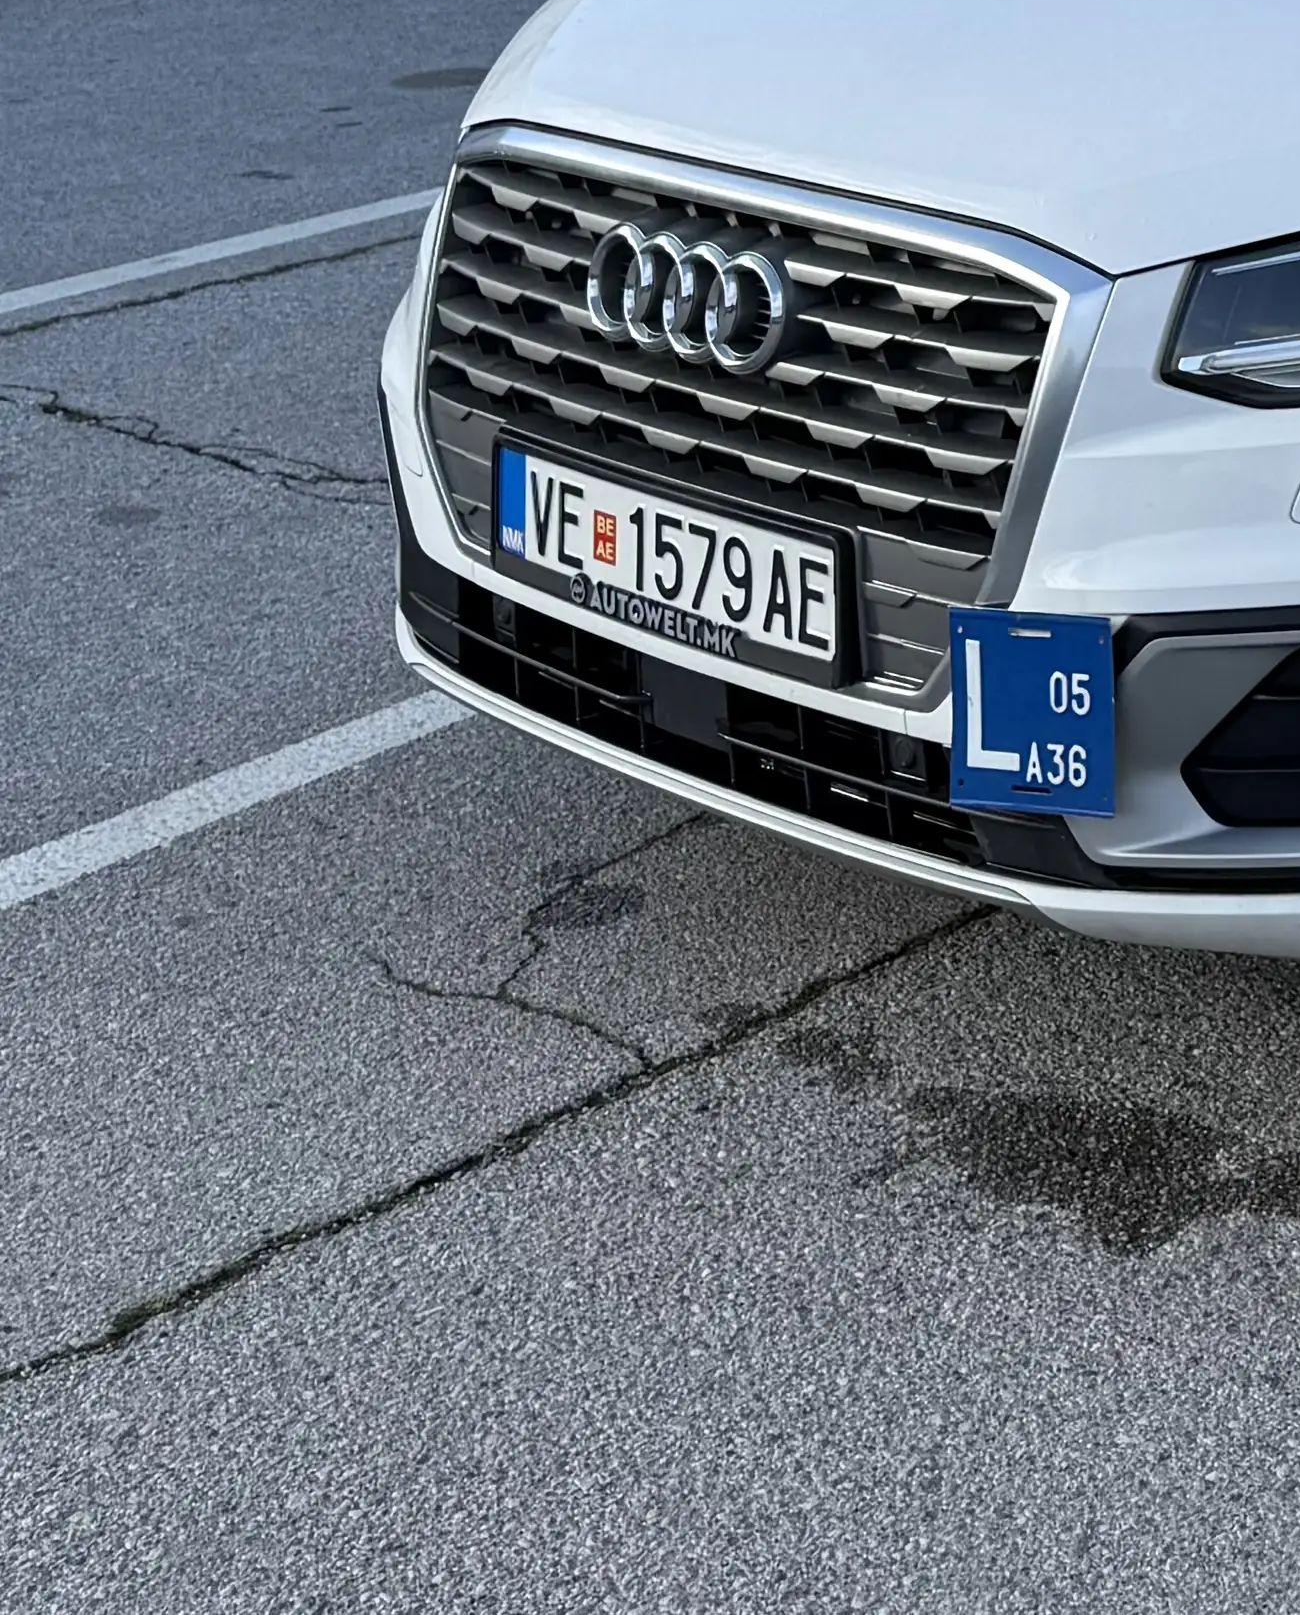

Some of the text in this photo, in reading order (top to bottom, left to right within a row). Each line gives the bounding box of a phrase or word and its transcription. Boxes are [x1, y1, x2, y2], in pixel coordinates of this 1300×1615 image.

[530, 470, 831, 652] VE 1579 AE
[589, 587, 736, 658] AUTOWELT.MK
[965, 638, 1020, 772] L
[1049, 670, 1091, 716] 05
[1025, 741, 1087, 788] A36
